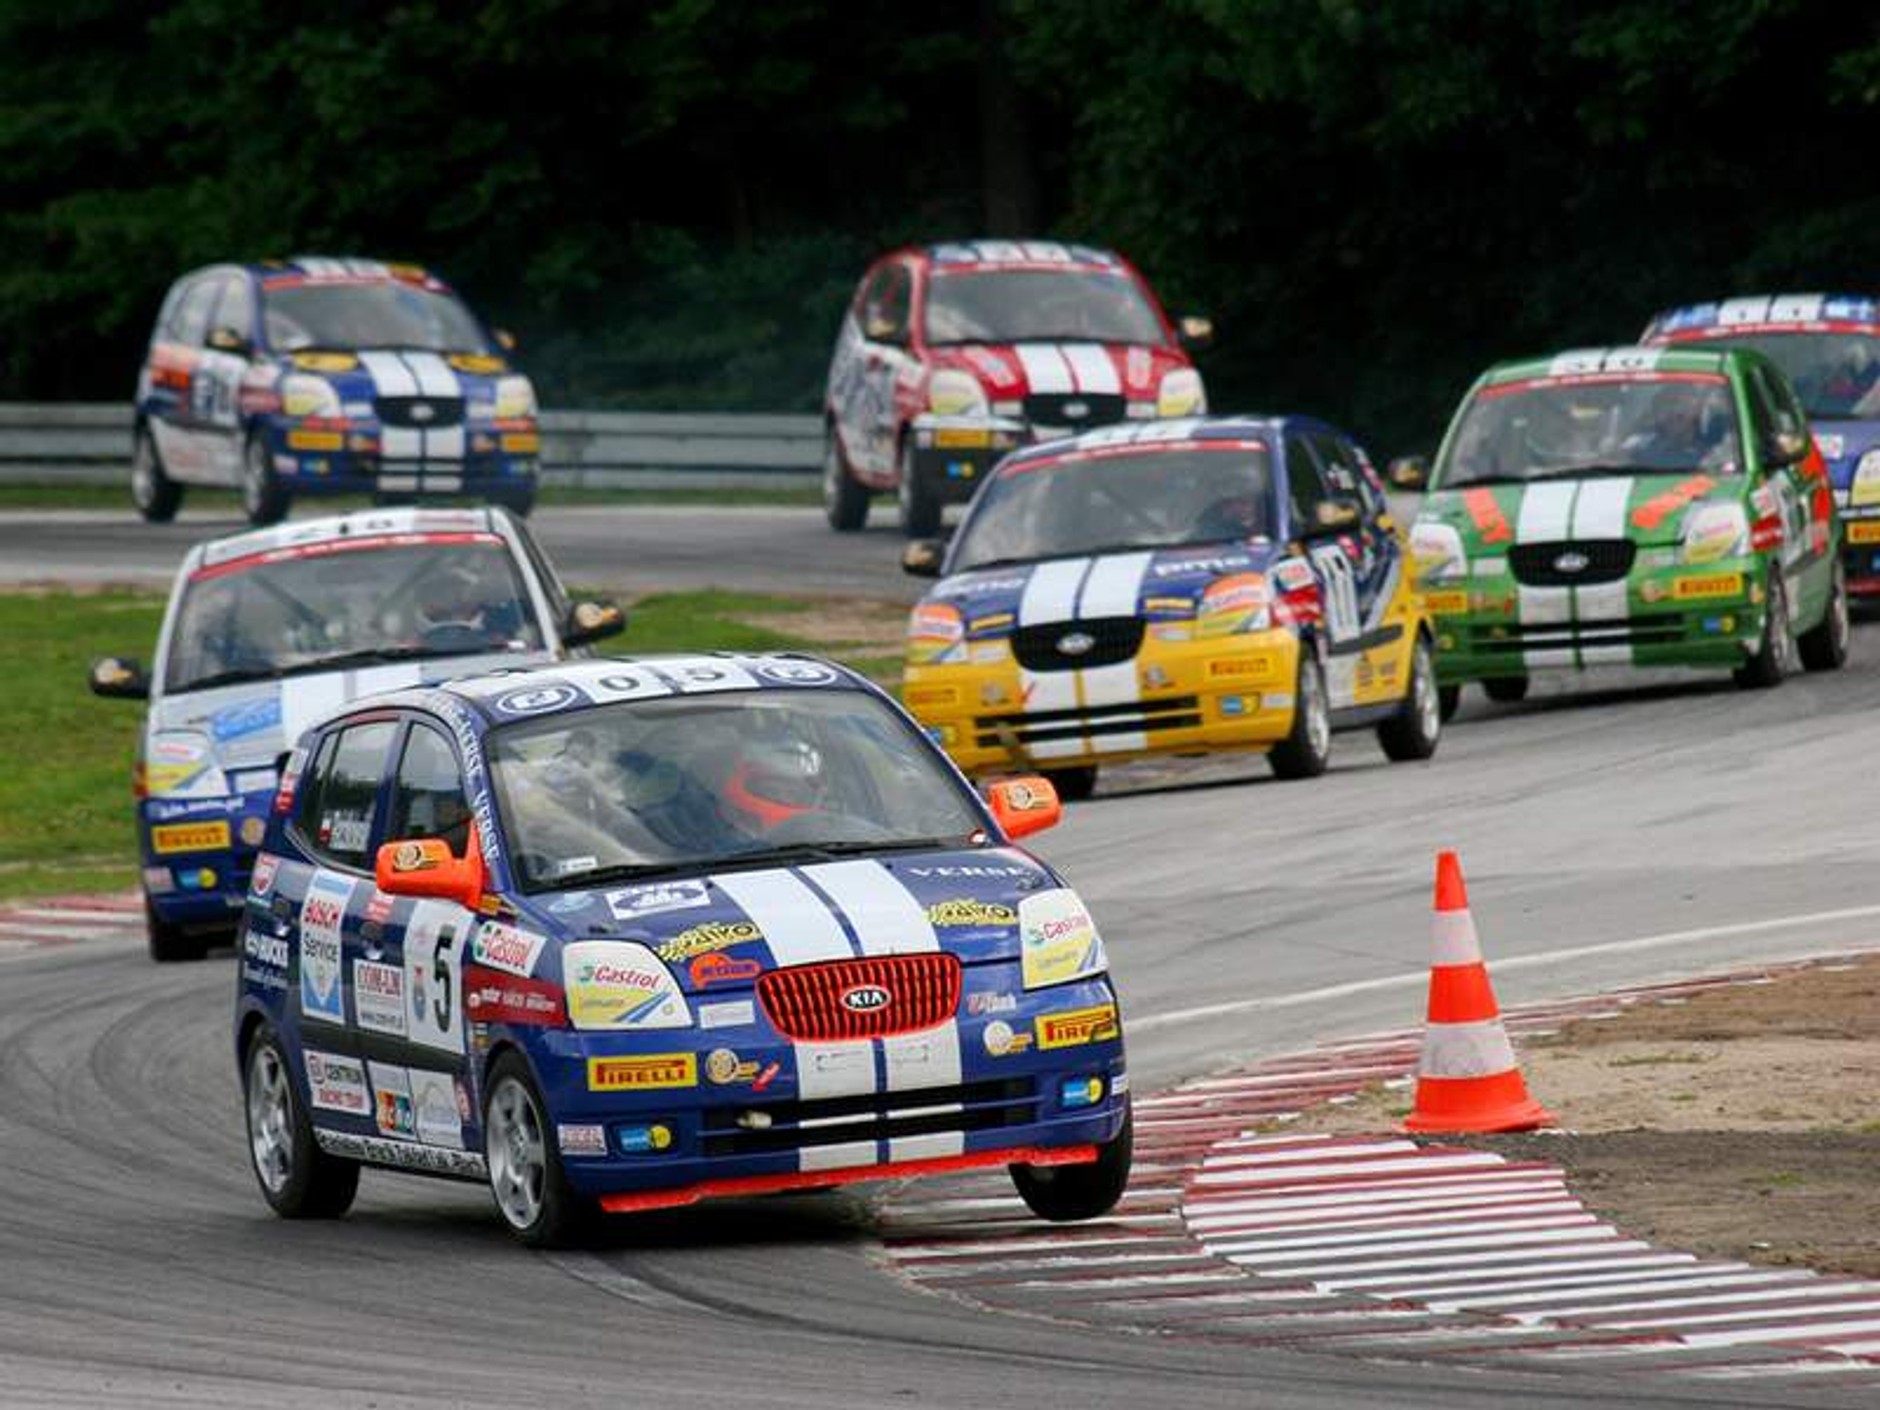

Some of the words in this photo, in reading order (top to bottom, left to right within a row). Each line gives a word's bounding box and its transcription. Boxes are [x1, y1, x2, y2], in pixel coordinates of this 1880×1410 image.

[599, 674, 641, 692] 0
[433, 925, 456, 1033] 5
[593, 964, 661, 989] Castrol
[848, 989, 885, 1006] KIA
[596, 1059, 688, 1085] PIRELLI
